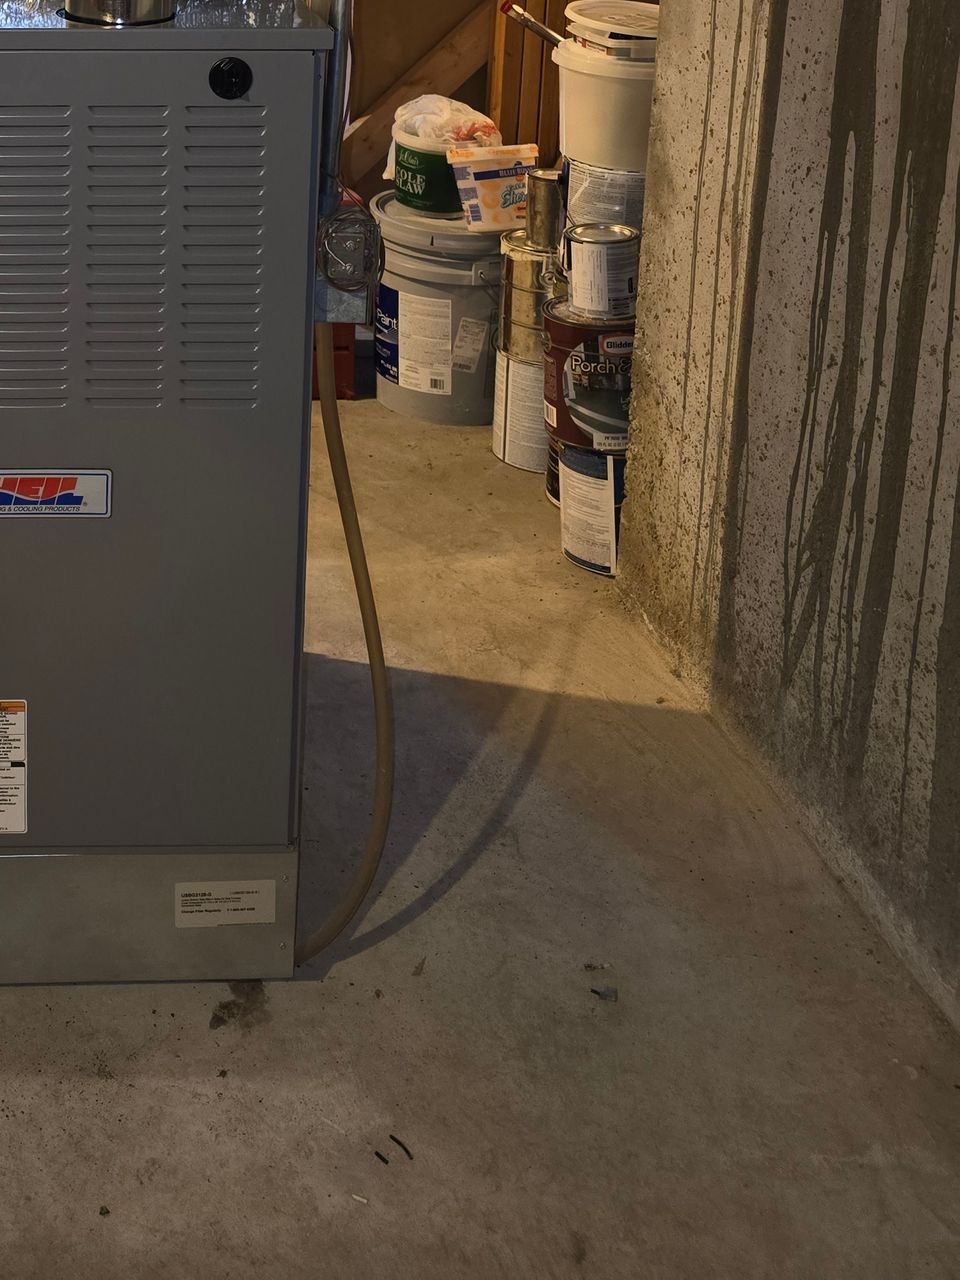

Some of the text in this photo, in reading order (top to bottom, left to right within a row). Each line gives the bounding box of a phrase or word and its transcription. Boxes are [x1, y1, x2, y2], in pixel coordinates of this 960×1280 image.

[396, 166, 426, 185] COLE
[499, 168, 516, 177] BLUE
[396, 177, 426, 196] SLAW
[376, 308, 398, 329] Paint
[570, 355, 616, 373] Porch
